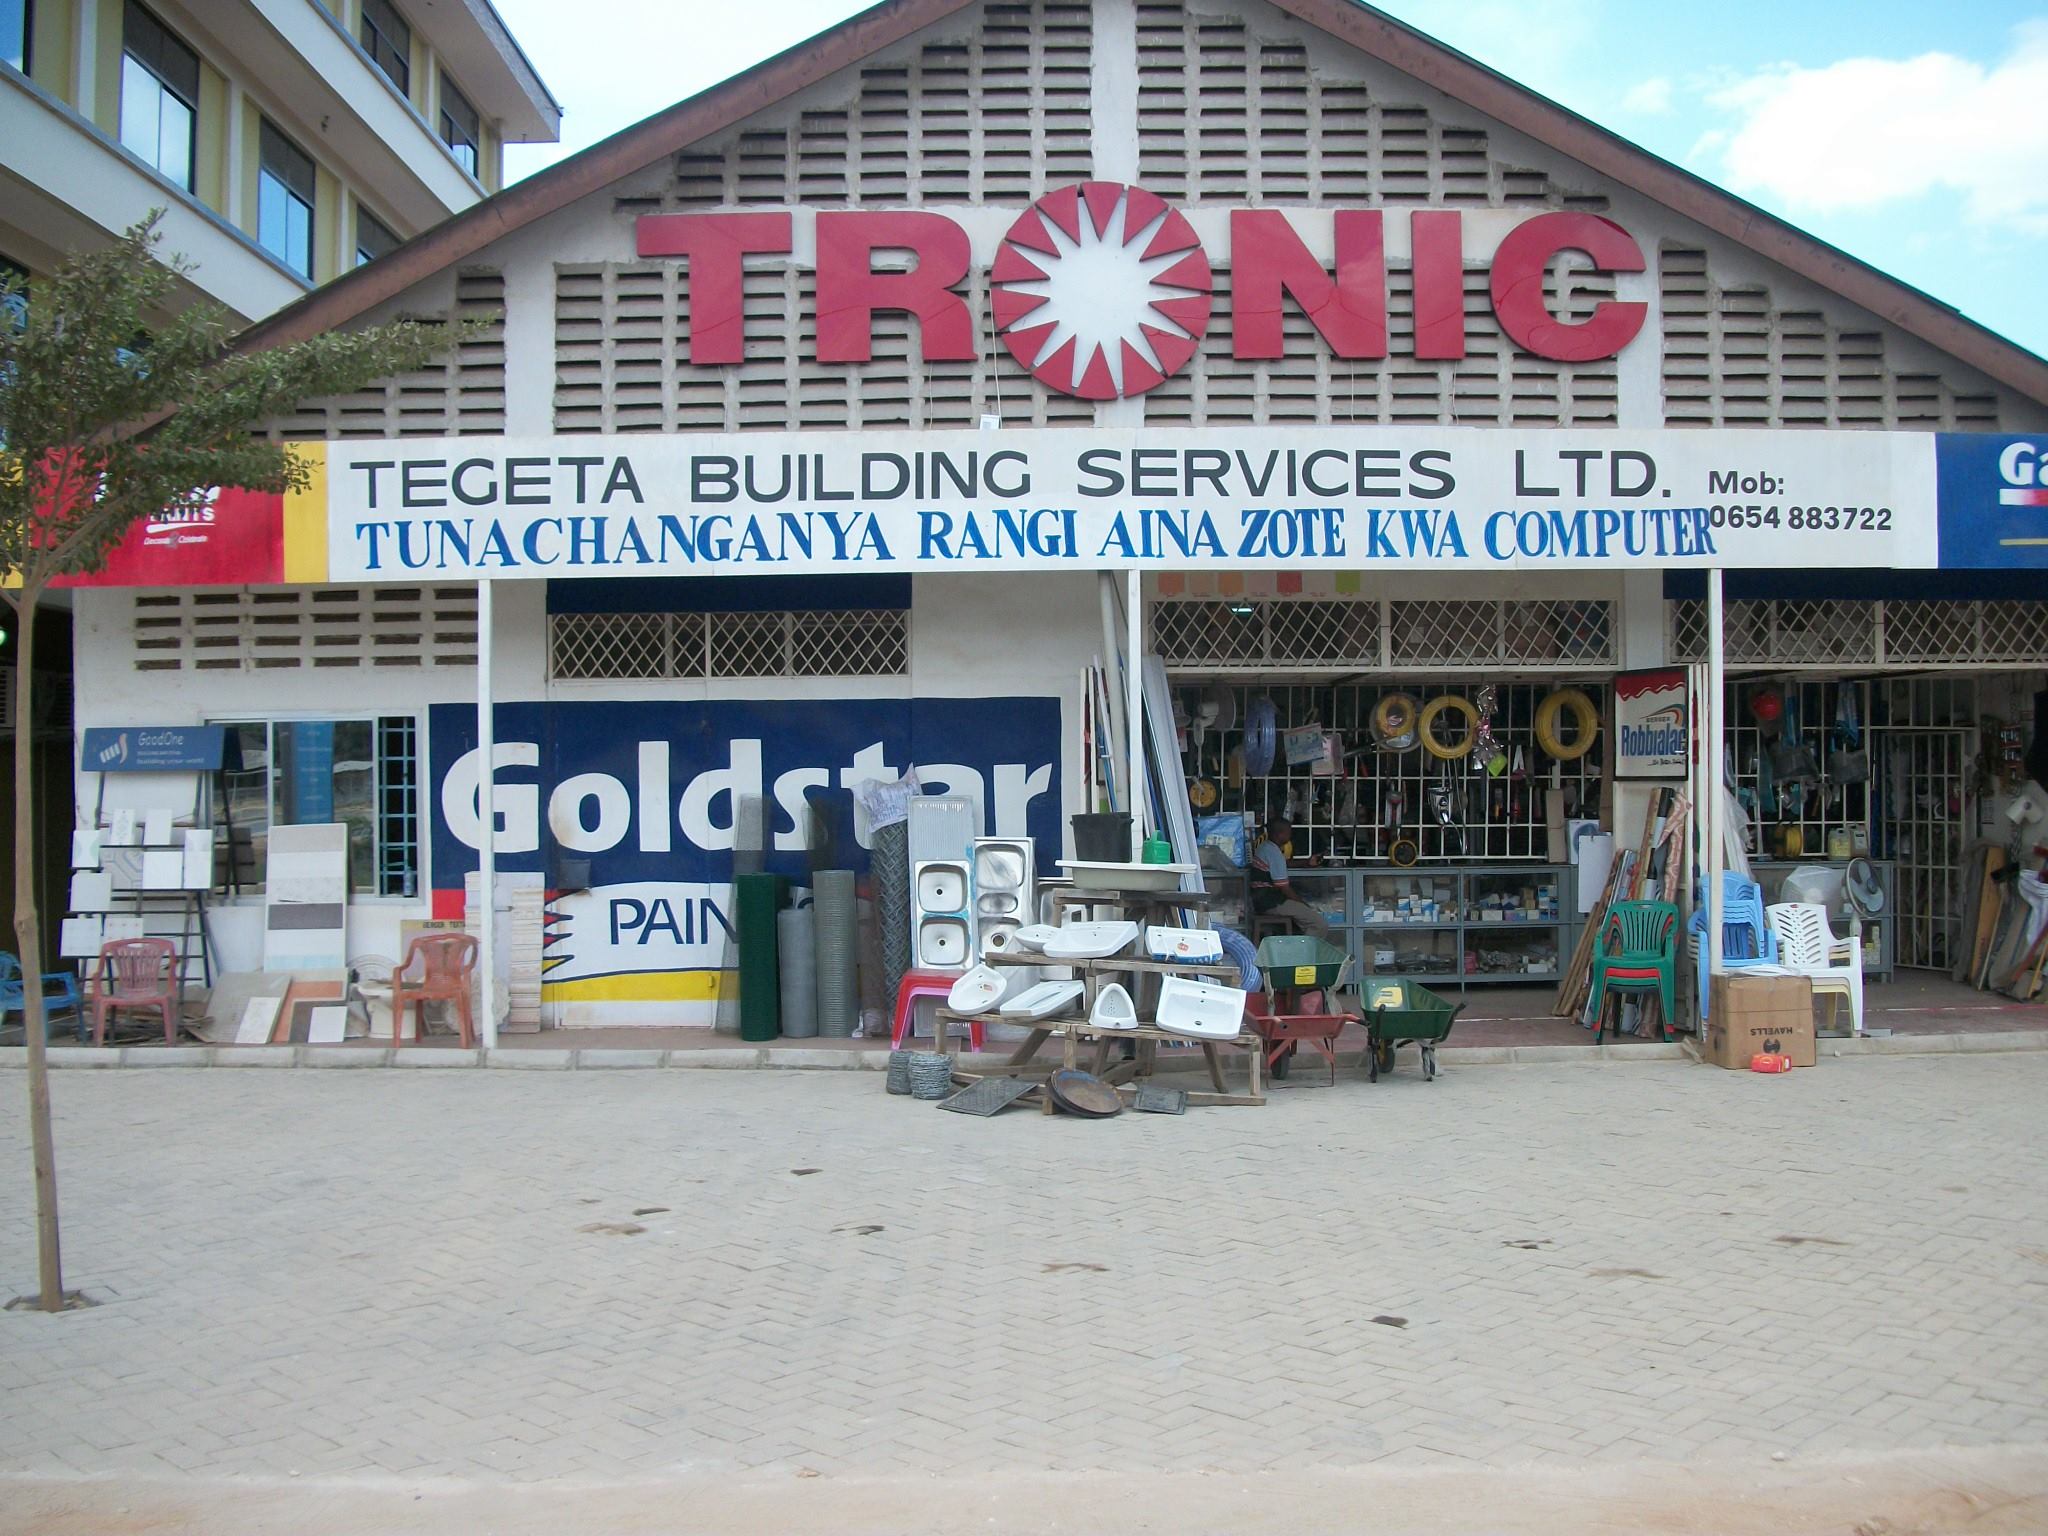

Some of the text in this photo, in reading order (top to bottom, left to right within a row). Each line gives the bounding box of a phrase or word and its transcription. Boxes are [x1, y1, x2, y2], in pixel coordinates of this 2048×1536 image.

[636, 181, 1648, 399] TRONIC
[350, 448, 1672, 509] TEGETA BUILDING SERVICES LTD.
[1708, 470, 1784, 495] Mob:
[355, 507, 1718, 570] TUNACHANGANYA RANGI AINA ZOTE KWA COMPUTER
[1709, 505, 1892, 531] 0654 883722
[1621, 722, 1687, 757] Robbialac
[441, 738, 1053, 853] Goldstar
[609, 898, 741, 945] PAIN
[1750, 1026, 1793, 1037] HAVELLS
